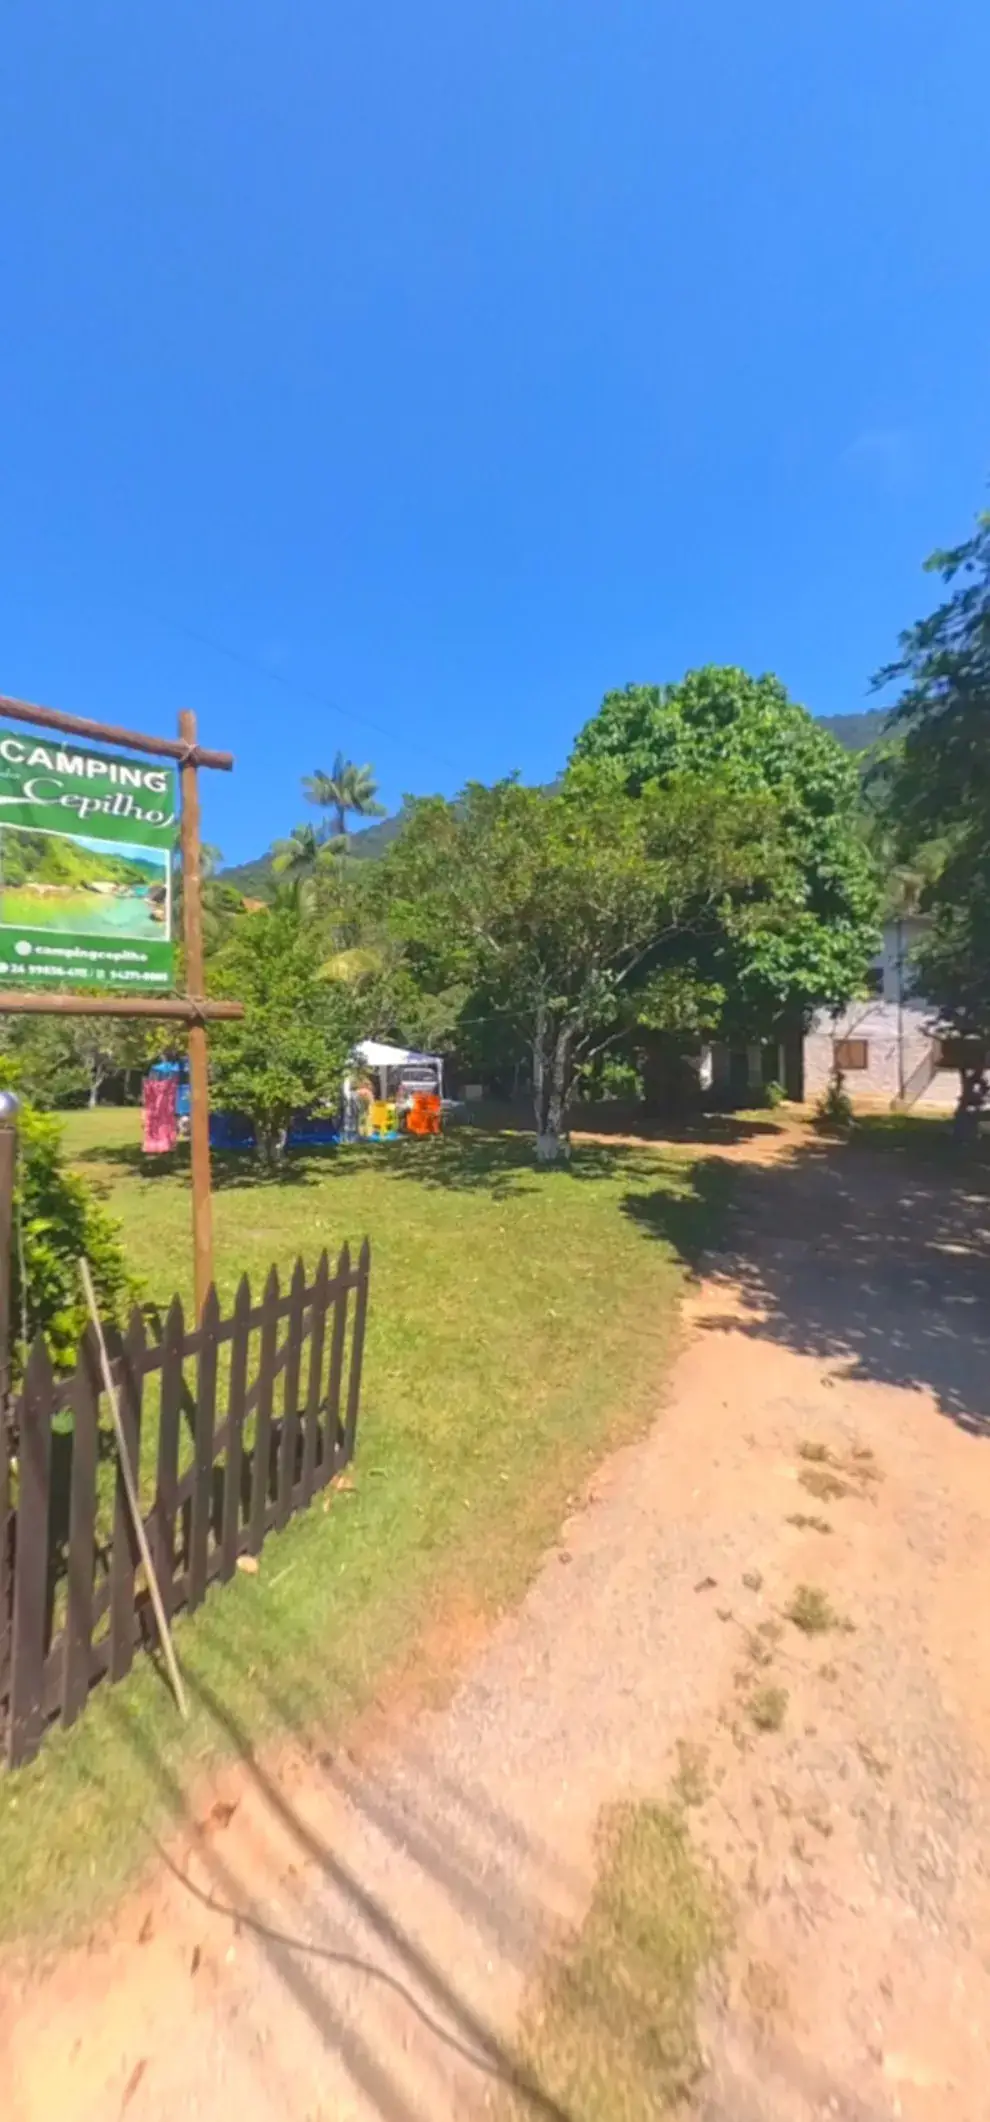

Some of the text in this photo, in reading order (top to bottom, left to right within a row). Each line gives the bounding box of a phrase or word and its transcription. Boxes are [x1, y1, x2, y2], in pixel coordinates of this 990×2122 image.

[0, 739, 168, 793] CAMPING
[23, 777, 174, 828] Cepilho
[34, 945, 149, 962] campingcepilho
